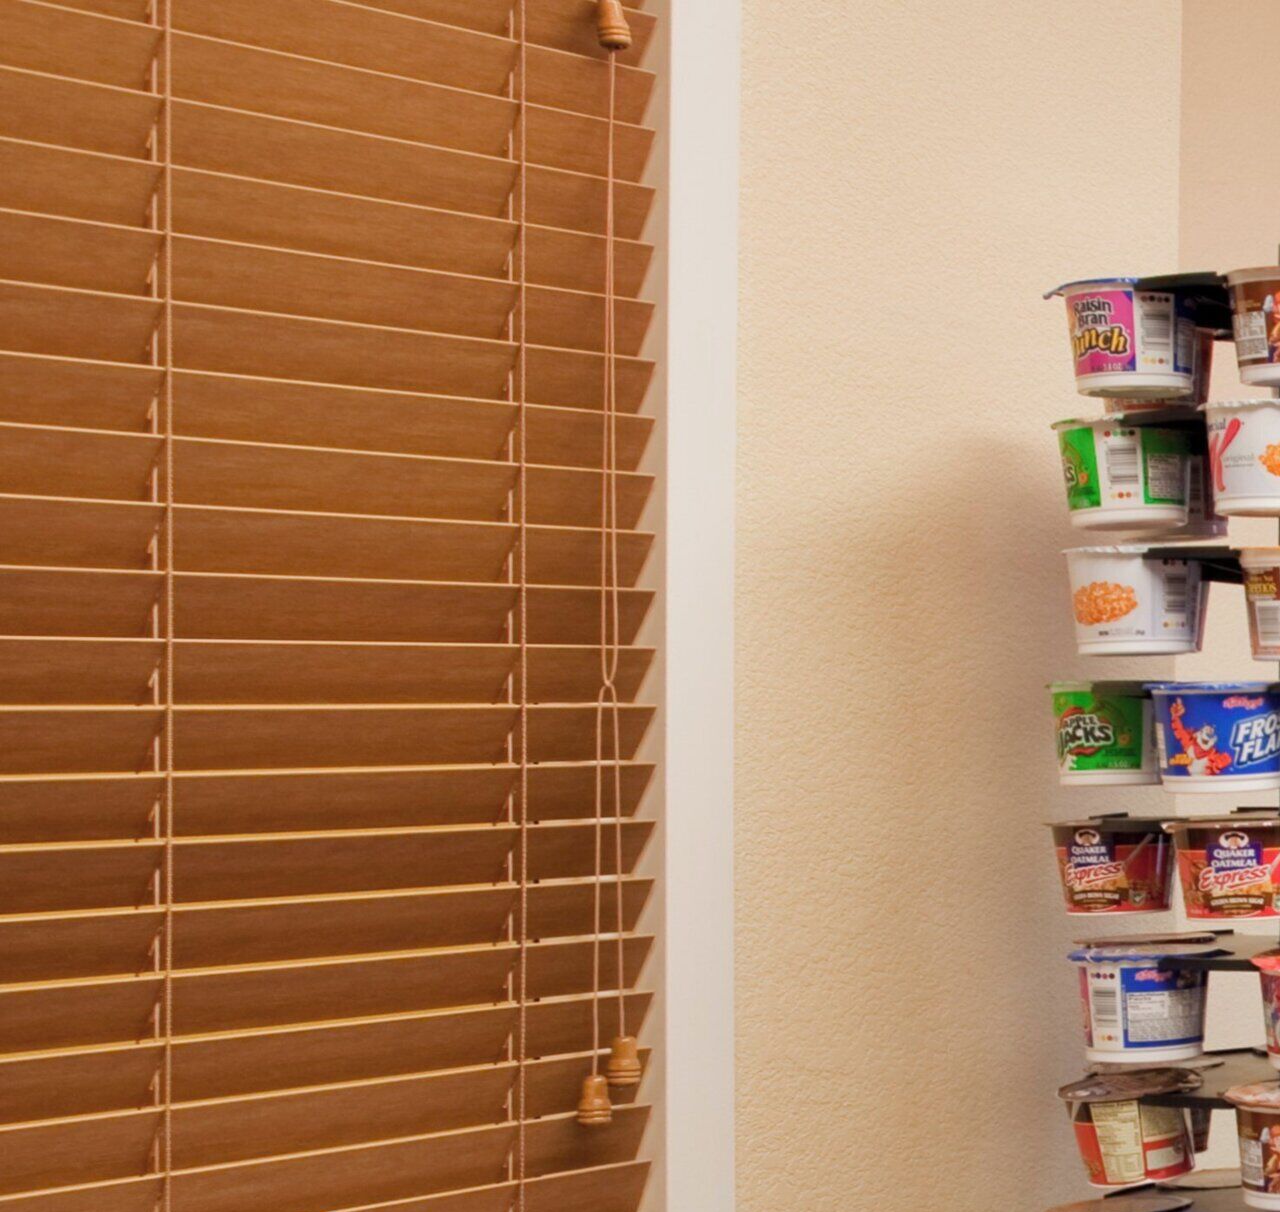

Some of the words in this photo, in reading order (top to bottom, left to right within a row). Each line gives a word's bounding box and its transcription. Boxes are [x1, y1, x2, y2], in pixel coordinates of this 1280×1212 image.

[1063, 715, 1098, 727] APPLE
[1058, 724, 1113, 752] JACKS
[1213, 848, 1254, 858] QUAKER
[1064, 863, 1122, 885] Express
[1200, 865, 1269, 891] Express
